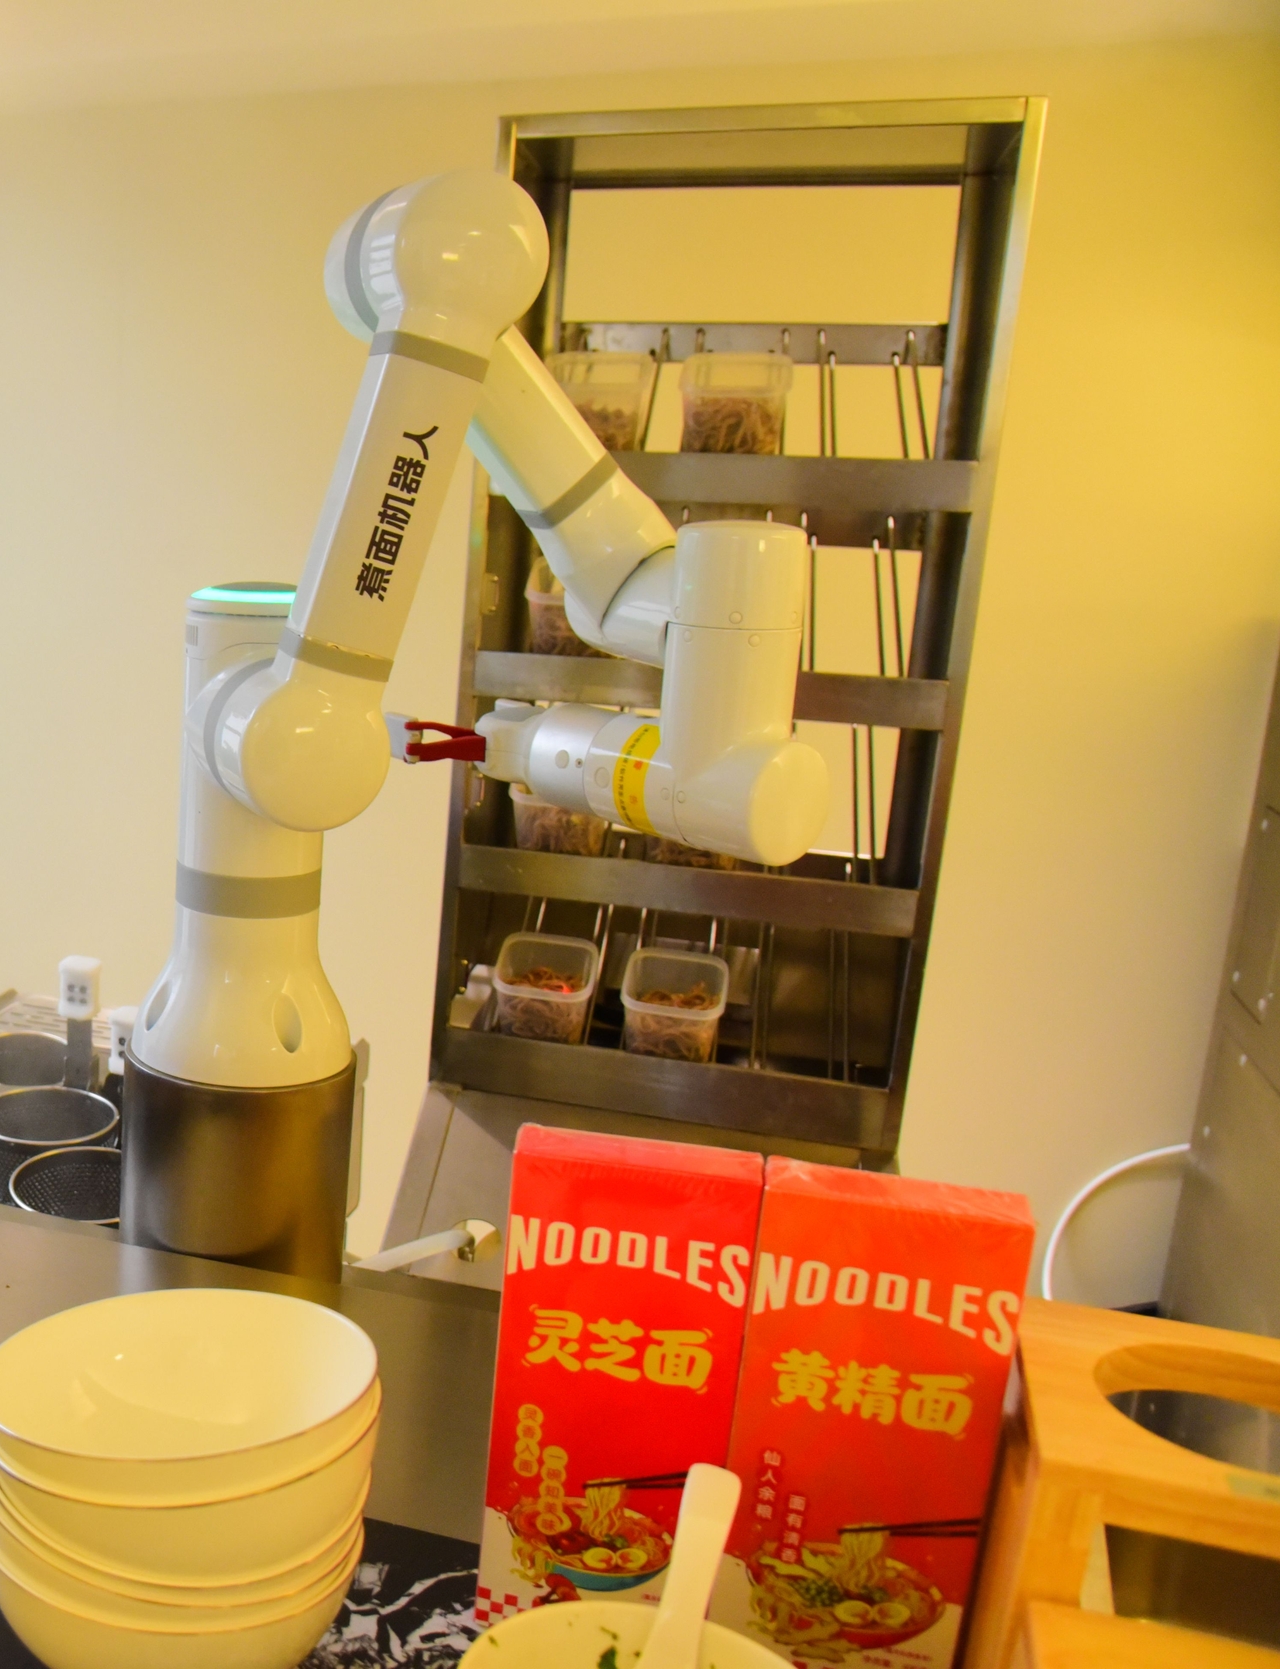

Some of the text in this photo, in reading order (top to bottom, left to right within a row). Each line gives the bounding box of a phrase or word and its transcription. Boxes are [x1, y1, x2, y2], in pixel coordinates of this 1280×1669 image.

[354, 425, 439, 602] 煮面机器人
[507, 1213, 751, 1308] NOODLES
[752, 1250, 1021, 1357] NOODLES
[524, 1307, 714, 1391] 灵芝面
[773, 1347, 974, 1437] 黄精面
